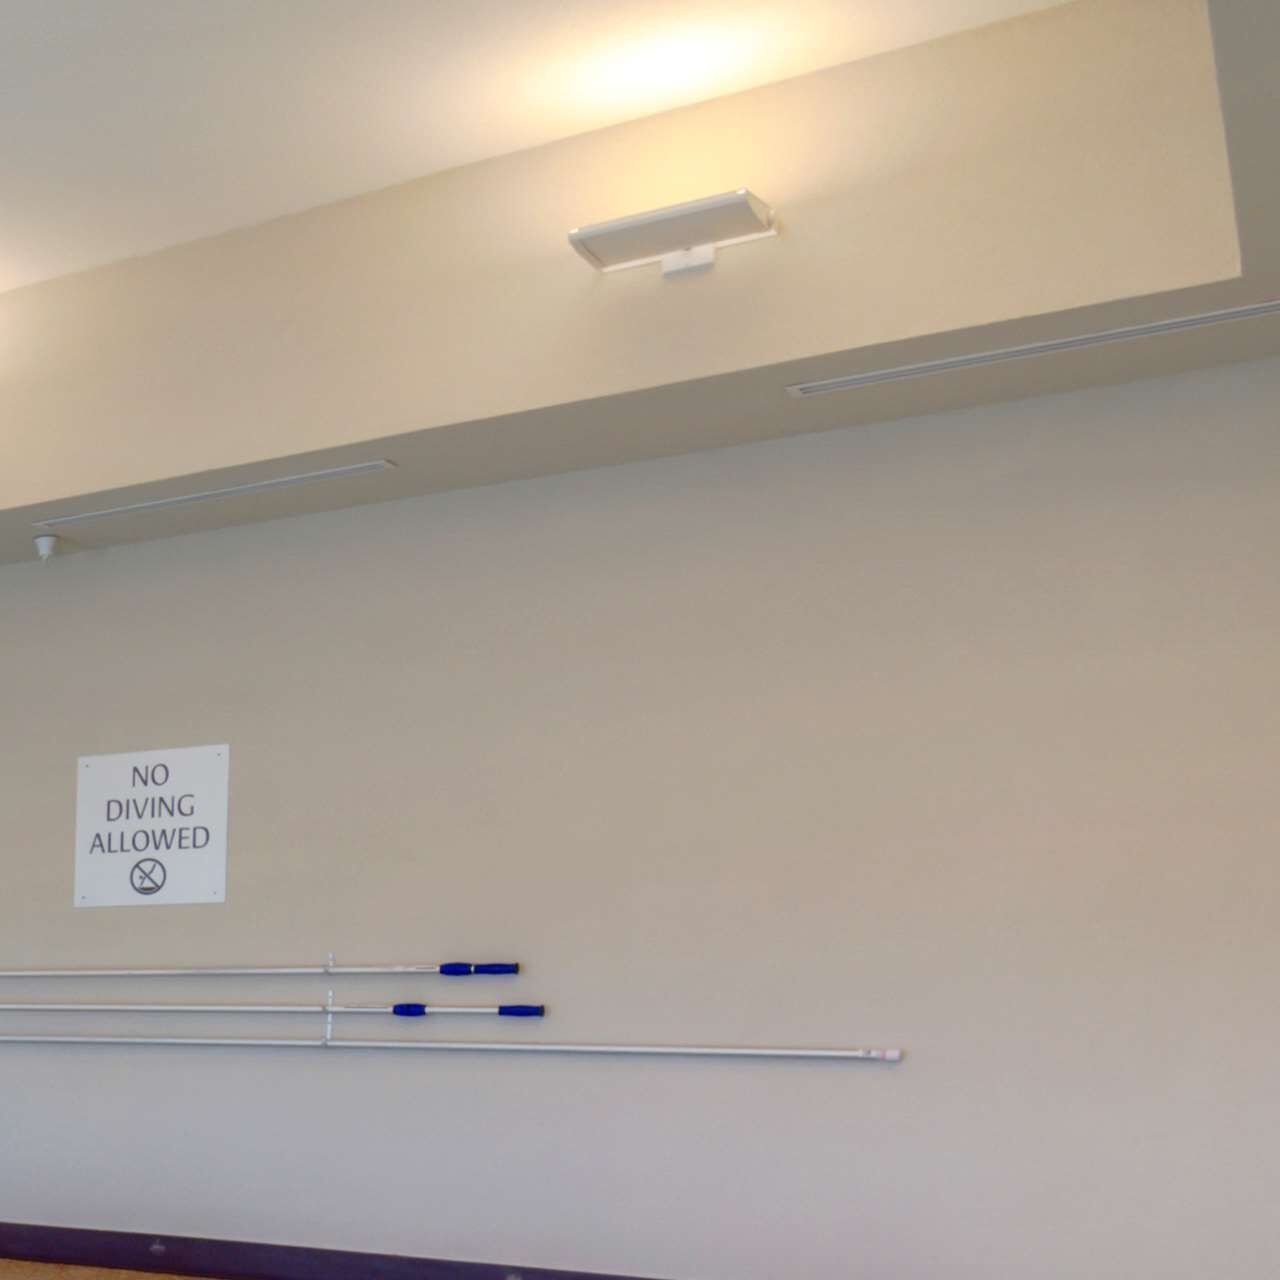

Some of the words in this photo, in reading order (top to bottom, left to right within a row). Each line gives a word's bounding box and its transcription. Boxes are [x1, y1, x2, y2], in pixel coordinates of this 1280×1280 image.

[132, 763, 170, 788] NO
[106, 793, 196, 823] DIVING
[89, 826, 211, 855] ALLOWED
